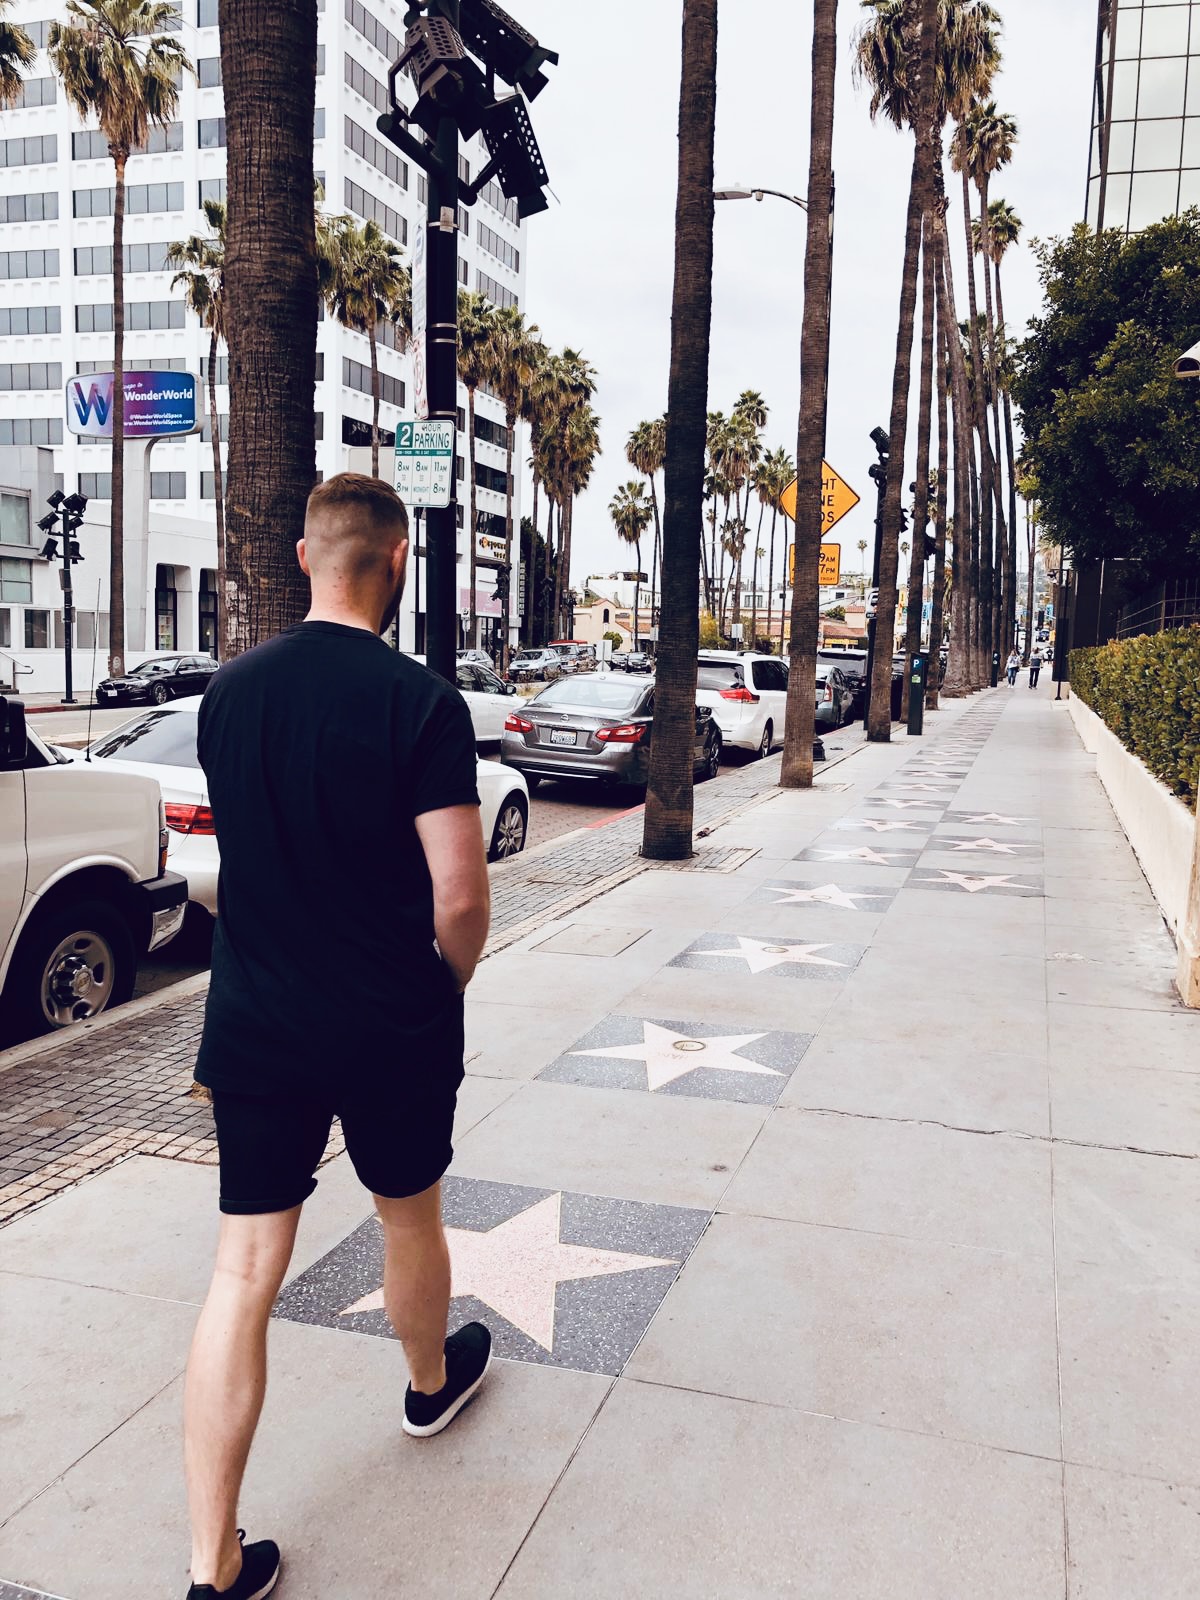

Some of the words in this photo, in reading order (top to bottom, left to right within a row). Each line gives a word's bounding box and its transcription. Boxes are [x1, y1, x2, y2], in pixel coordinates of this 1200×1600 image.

[124, 389, 193, 401] WonderWorld
[400, 425, 411, 446] 2
[415, 433, 449, 448] PARKING
[821, 495, 834, 507] NE
